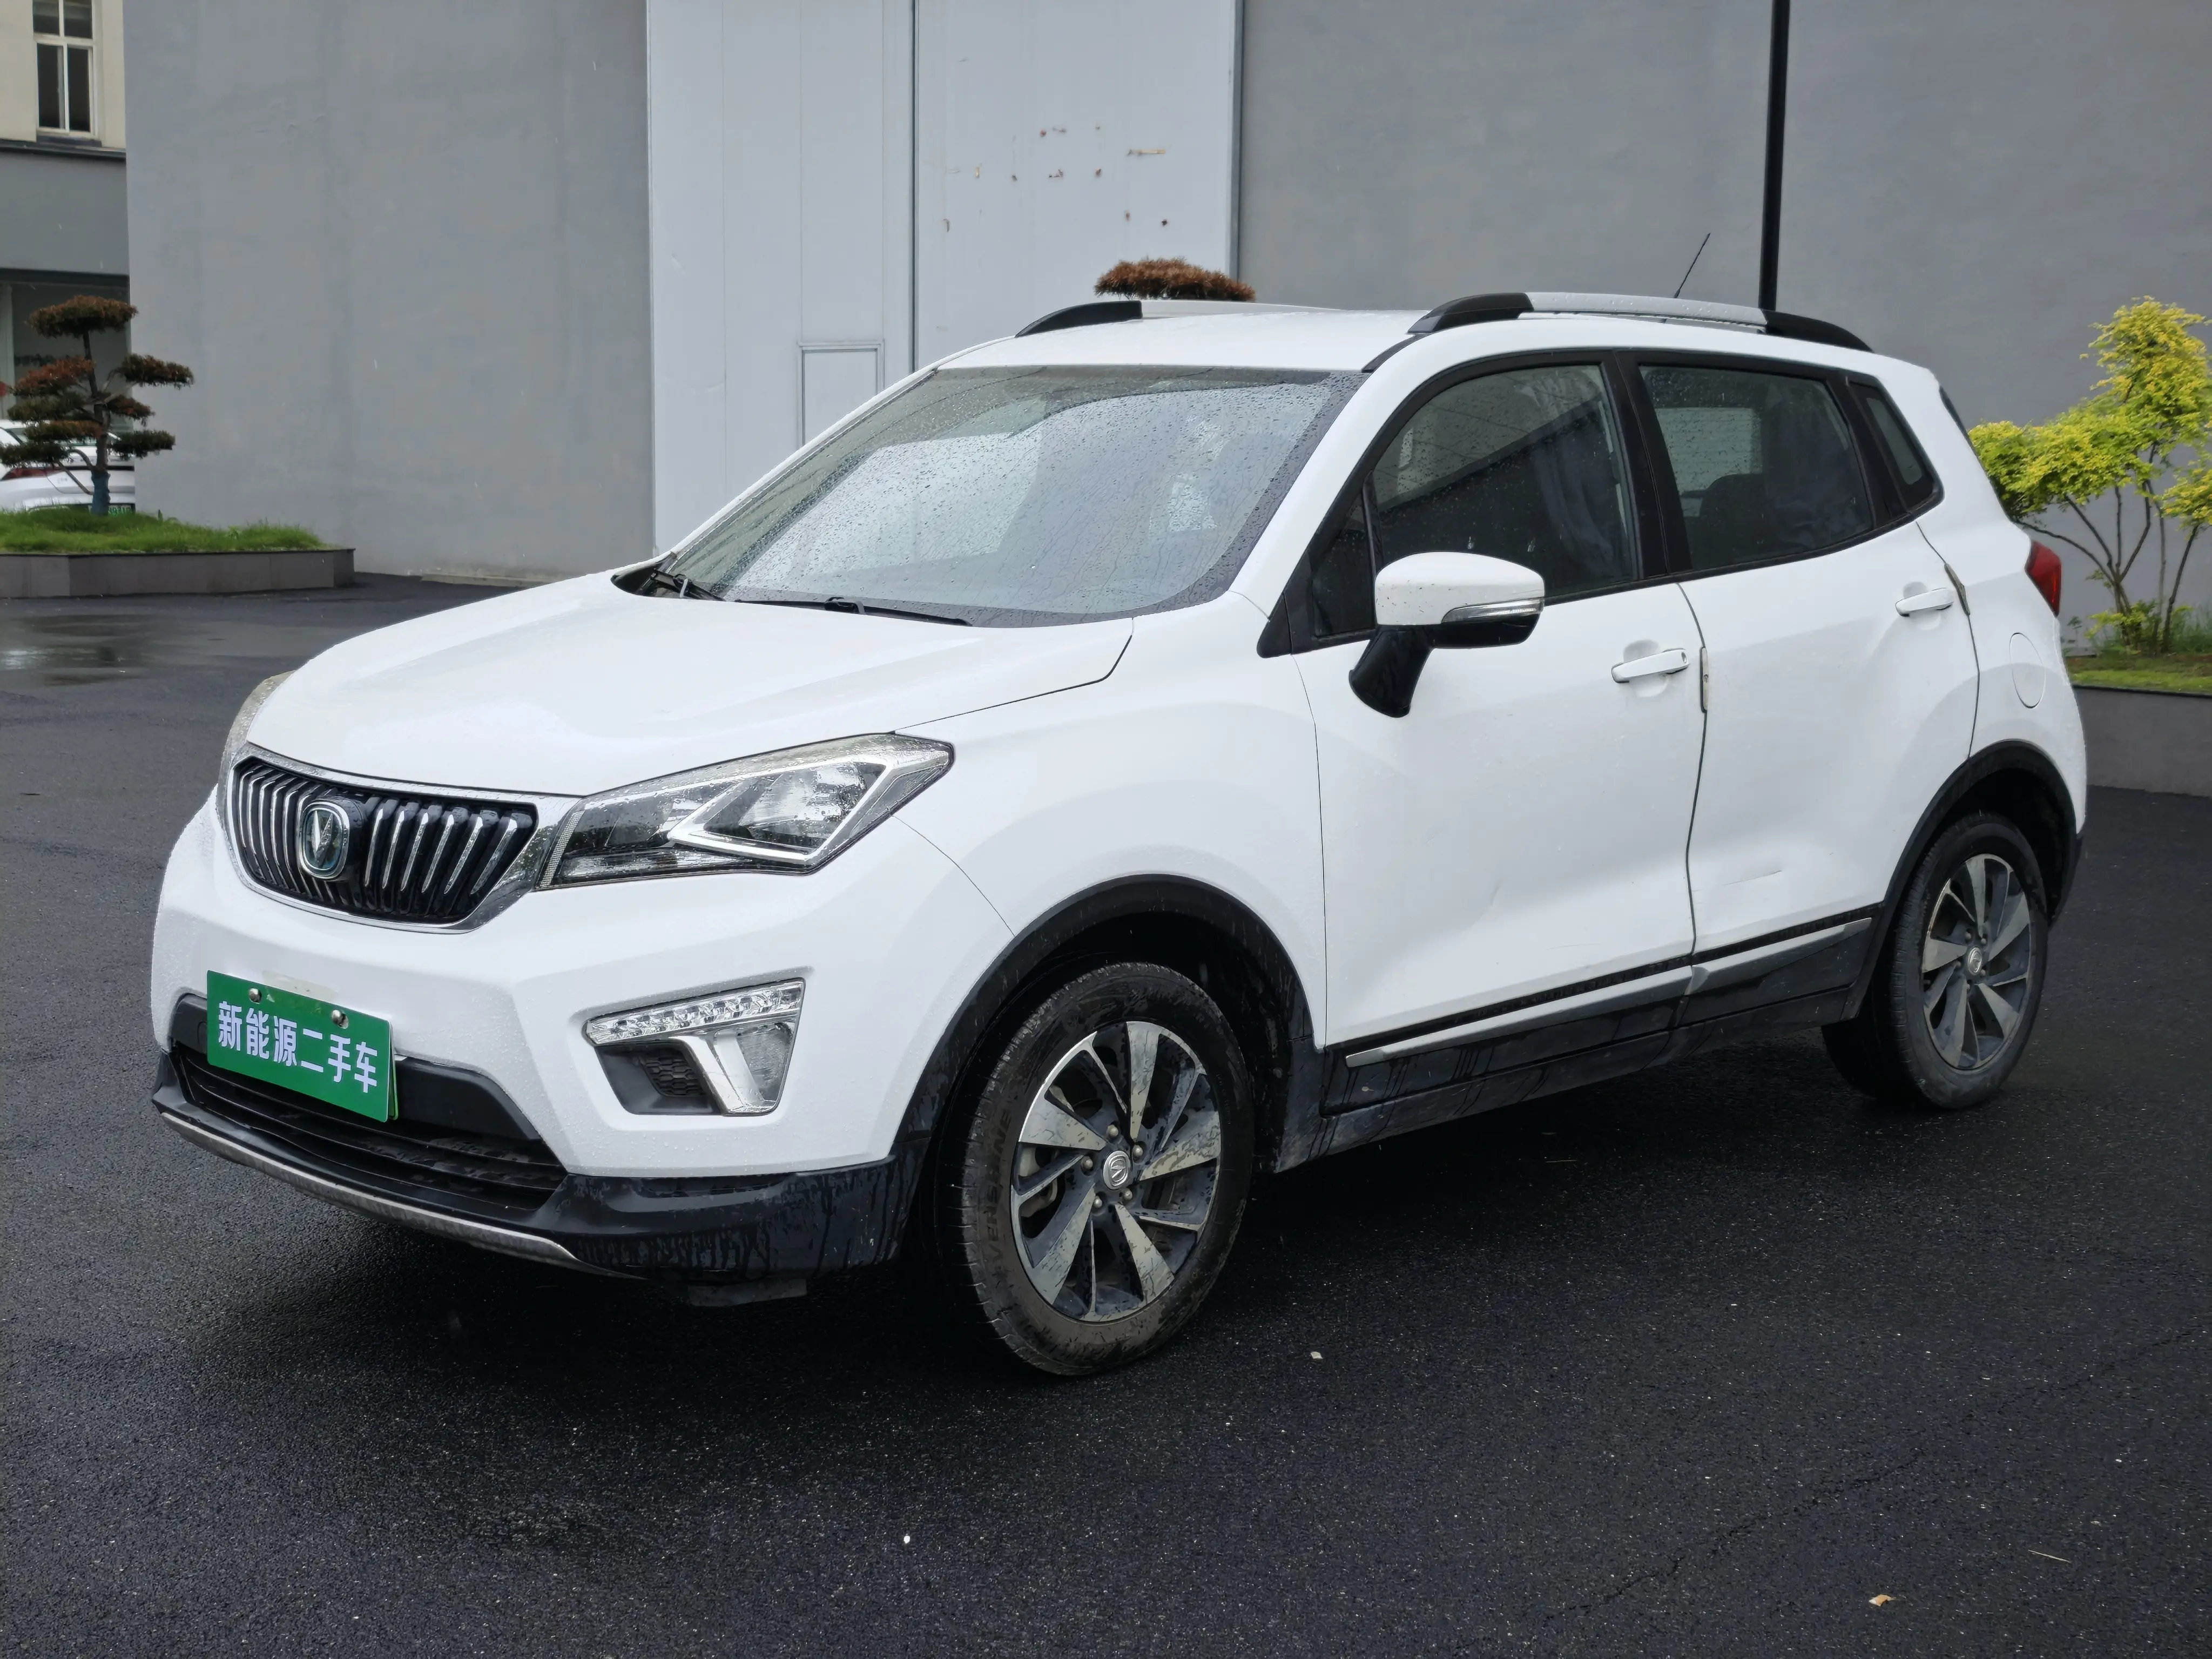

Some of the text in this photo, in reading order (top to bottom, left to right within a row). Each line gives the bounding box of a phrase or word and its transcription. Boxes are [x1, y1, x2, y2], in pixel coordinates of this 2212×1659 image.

[218, 1001, 377, 1093] 新能源二手车
